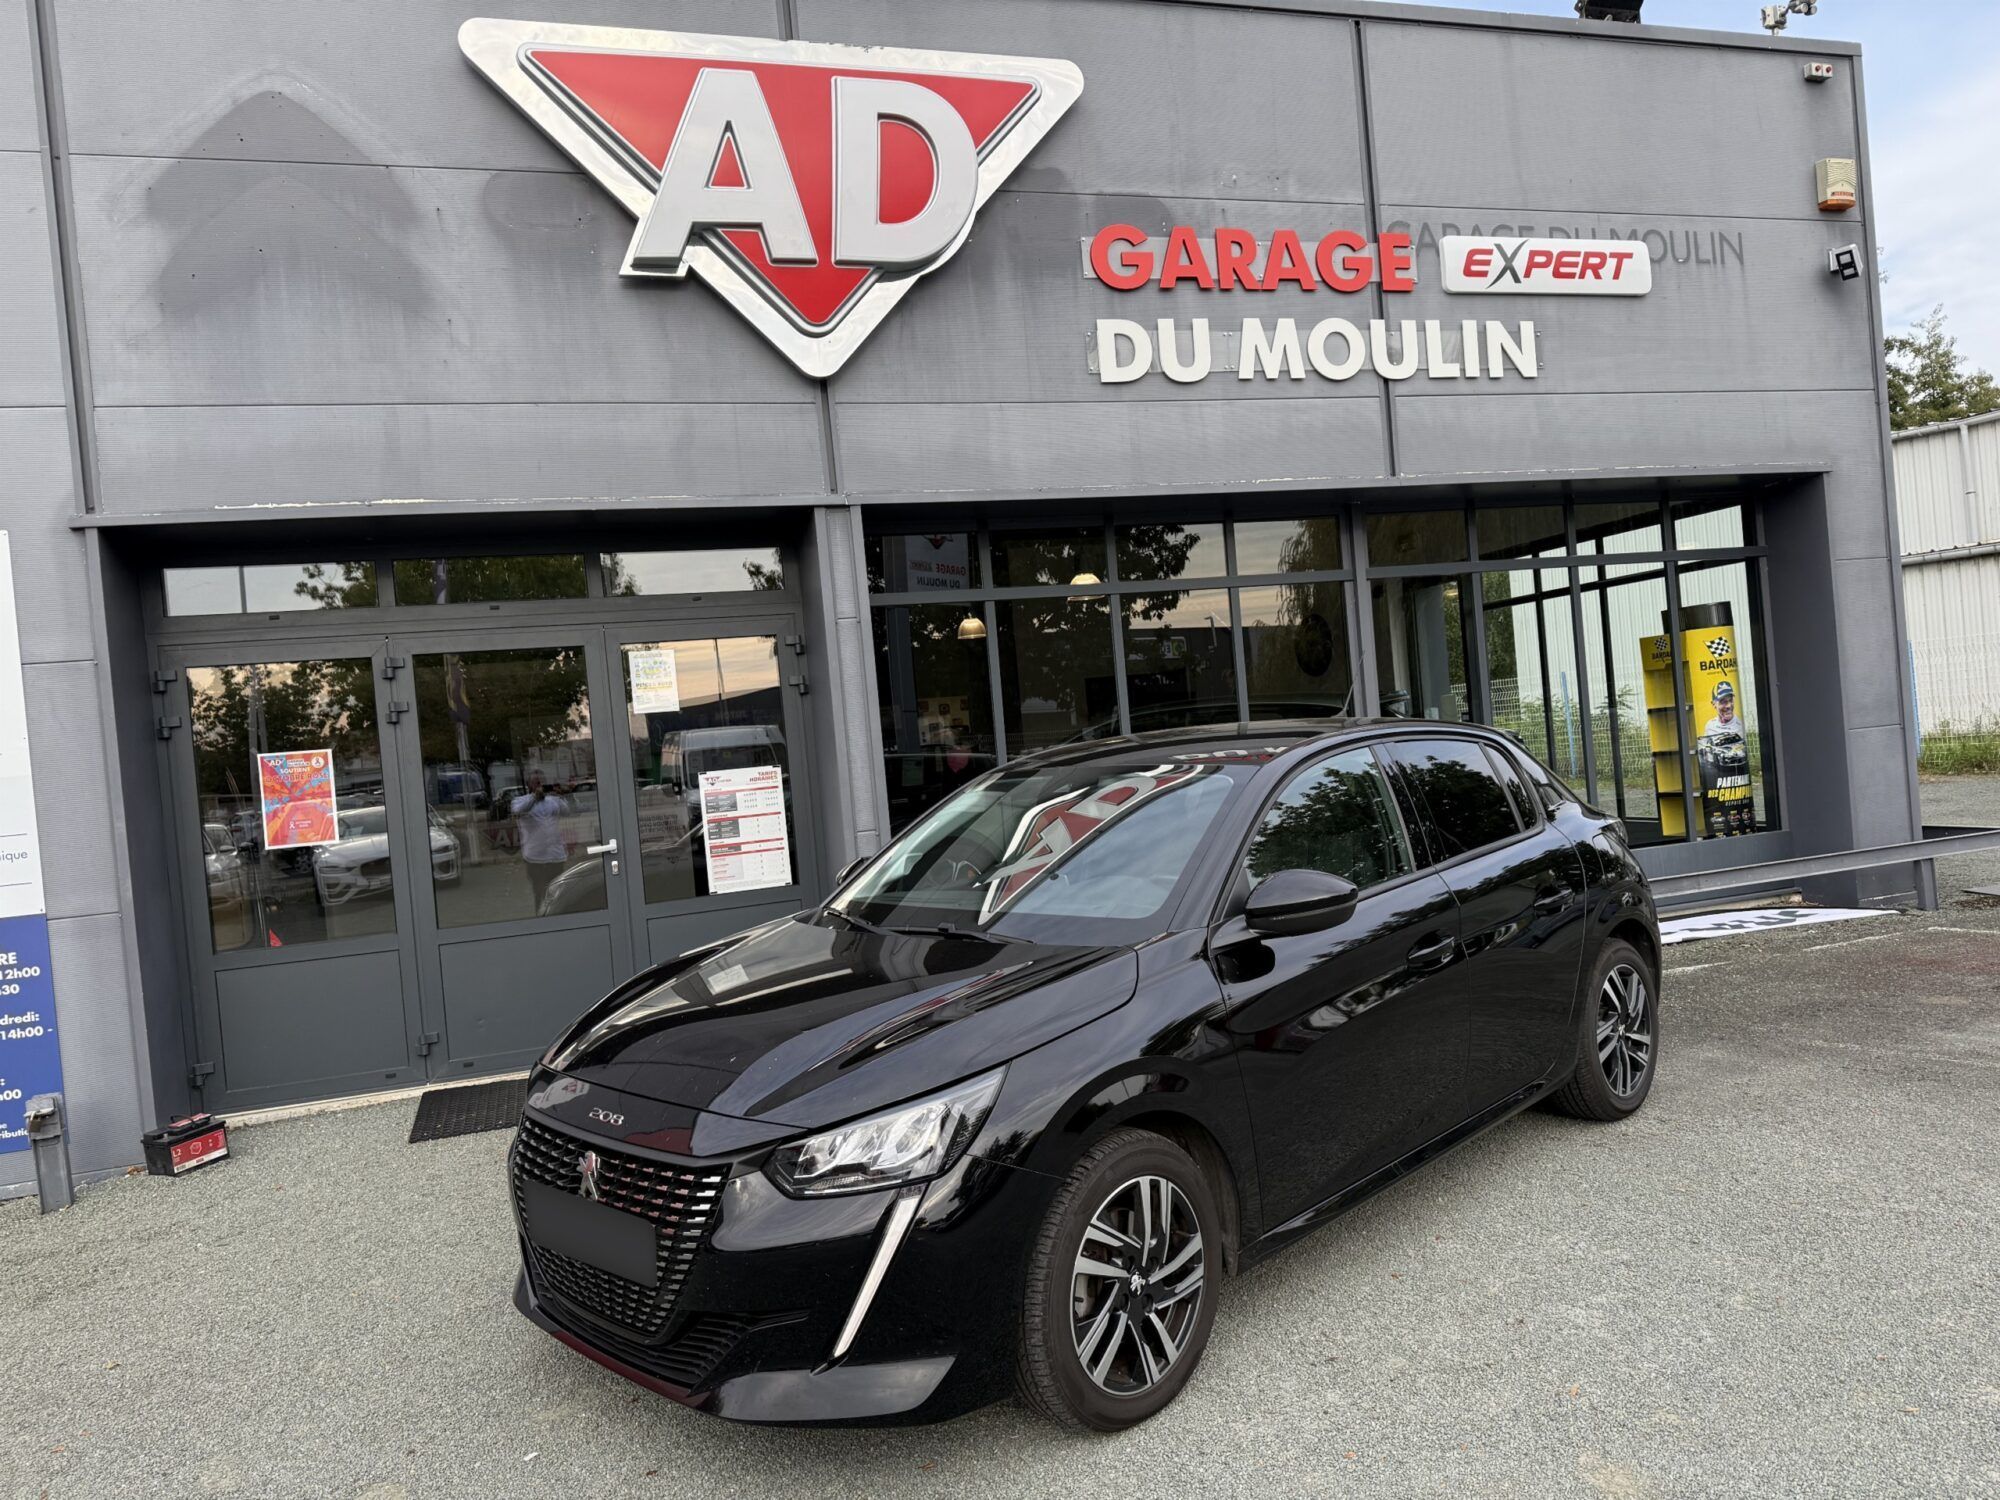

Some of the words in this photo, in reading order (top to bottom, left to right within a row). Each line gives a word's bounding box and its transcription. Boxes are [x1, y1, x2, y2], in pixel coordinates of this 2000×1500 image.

[630, 67, 979, 273] AD
[1090, 224, 1415, 292] GARAGE
[1462, 239, 1633, 289] EXPERT
[1096, 318, 1212, 383] DU
[1238, 317, 1538, 380] MOULIN
[0, 1025, 44, 1040] 14h00
[589, 1107, 625, 1126] 208
